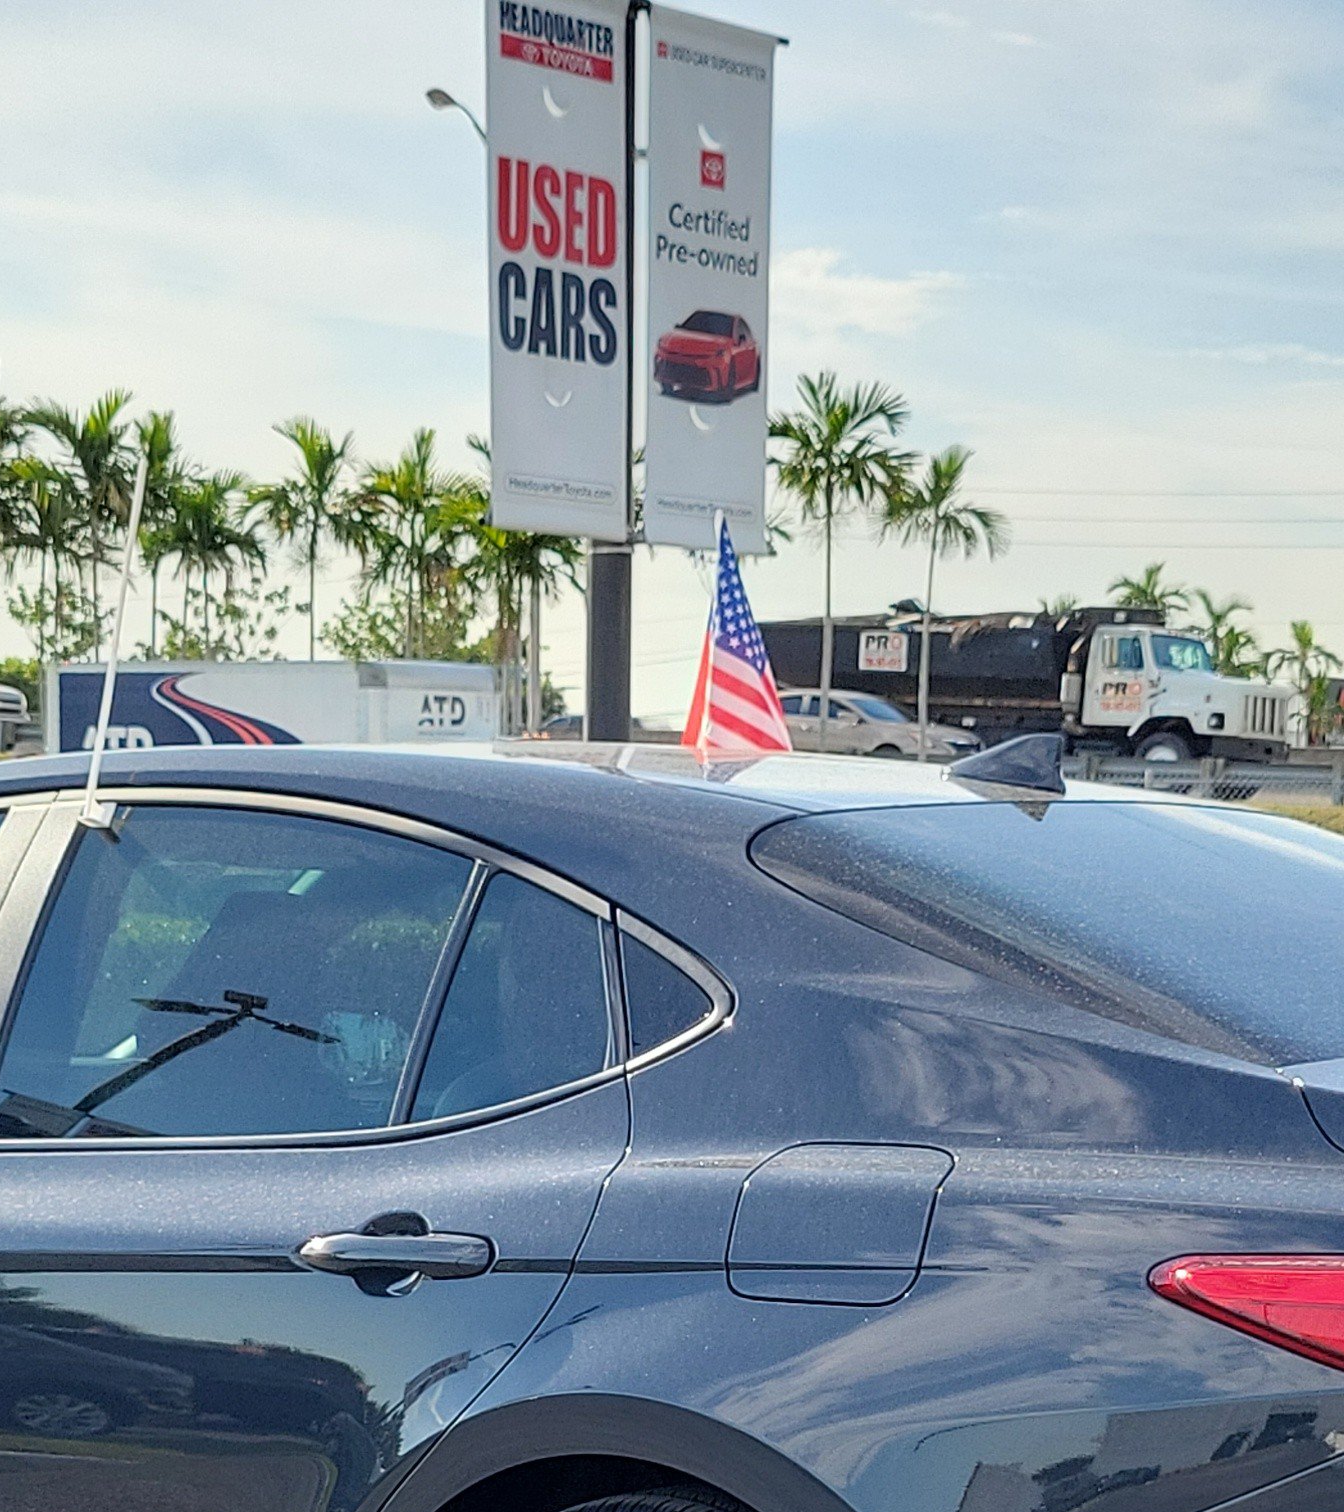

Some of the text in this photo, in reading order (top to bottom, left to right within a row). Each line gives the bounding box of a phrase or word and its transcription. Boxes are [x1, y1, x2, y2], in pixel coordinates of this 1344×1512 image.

[499, 1, 613, 57] HEADQUARTER
[542, 46, 594, 76] TOYOTA
[498, 156, 616, 269] USED
[669, 203, 751, 241] Certified
[656, 235, 759, 277] Pre-owned
[499, 262, 617, 366] CARS
[865, 635, 902, 650] PRO
[418, 695, 466, 726] ATD
